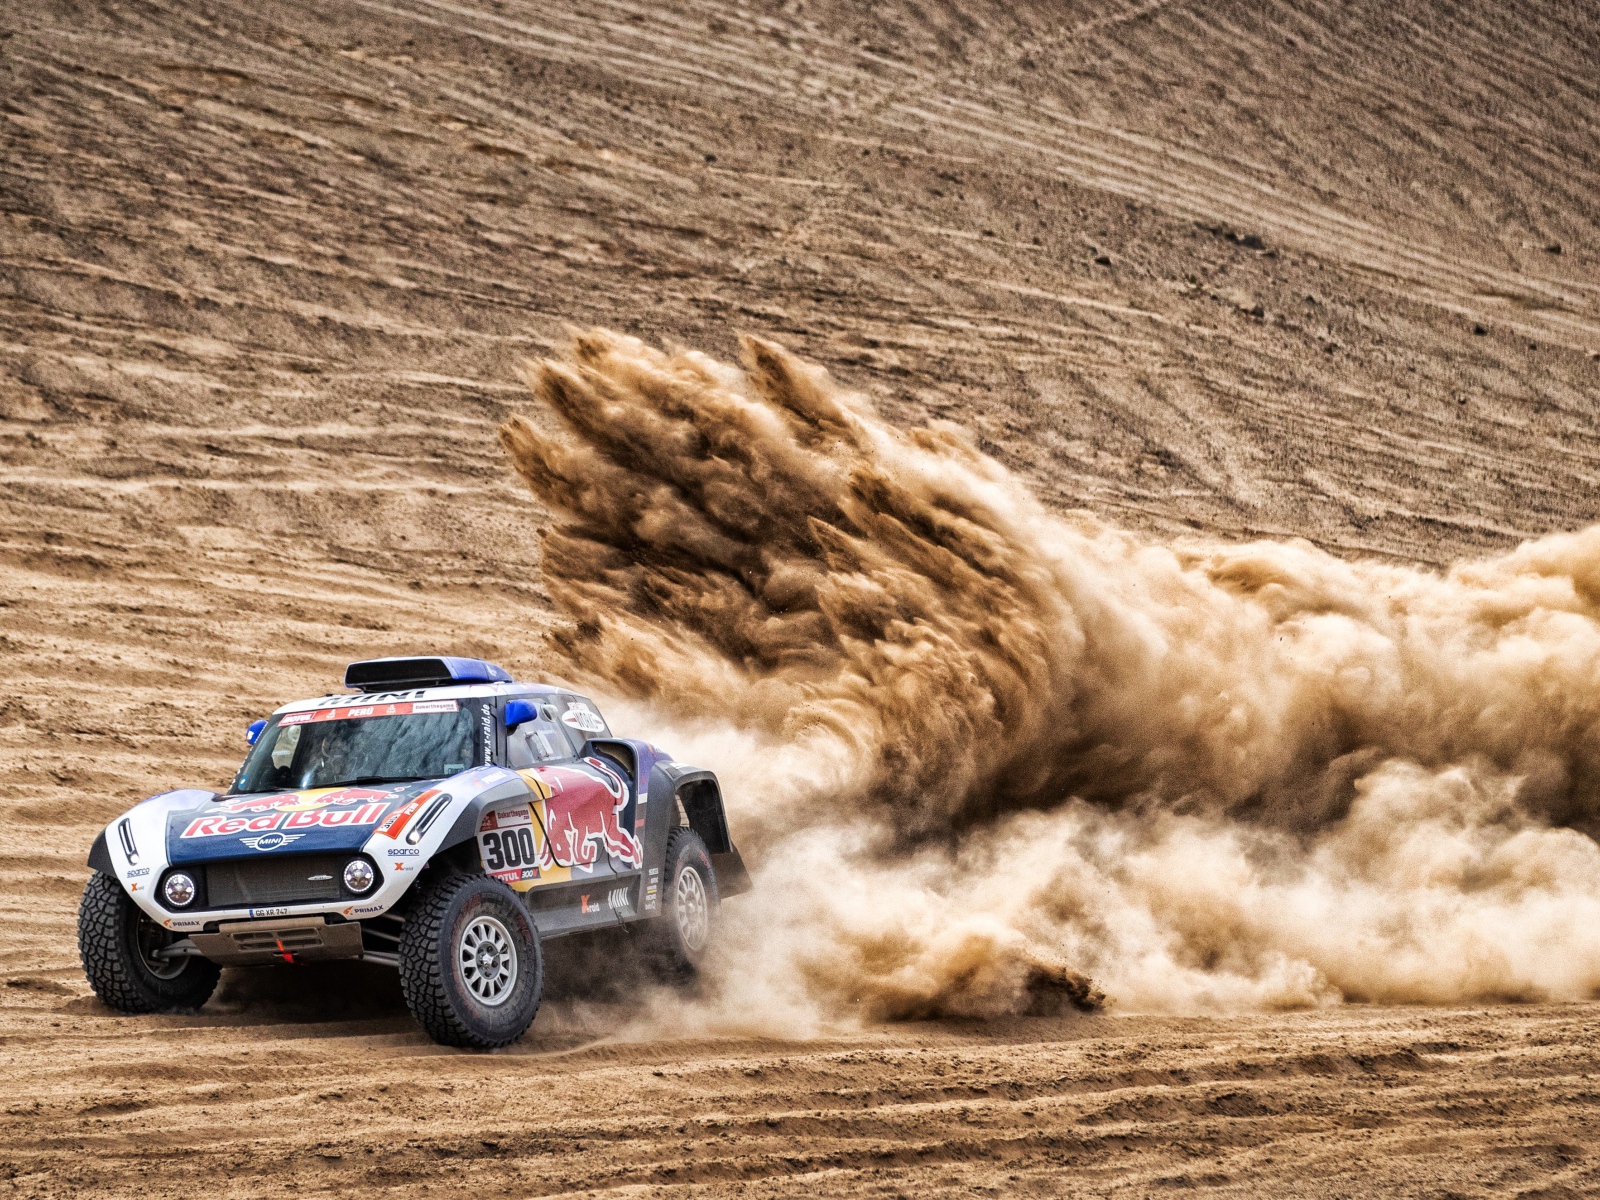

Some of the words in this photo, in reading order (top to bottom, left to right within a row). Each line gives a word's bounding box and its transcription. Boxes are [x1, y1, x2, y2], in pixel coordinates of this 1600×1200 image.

[318, 691, 425, 706] MINI
[184, 812, 285, 837] Red
[284, 803, 388, 828] Bull
[258, 837, 282, 845] MINI
[387, 848, 420, 856] sparco
[482, 827, 535, 870] 300
[127, 868, 150, 878] sparco
[521, 869, 538, 878] 300V
[354, 904, 384, 914] PRIMAX
